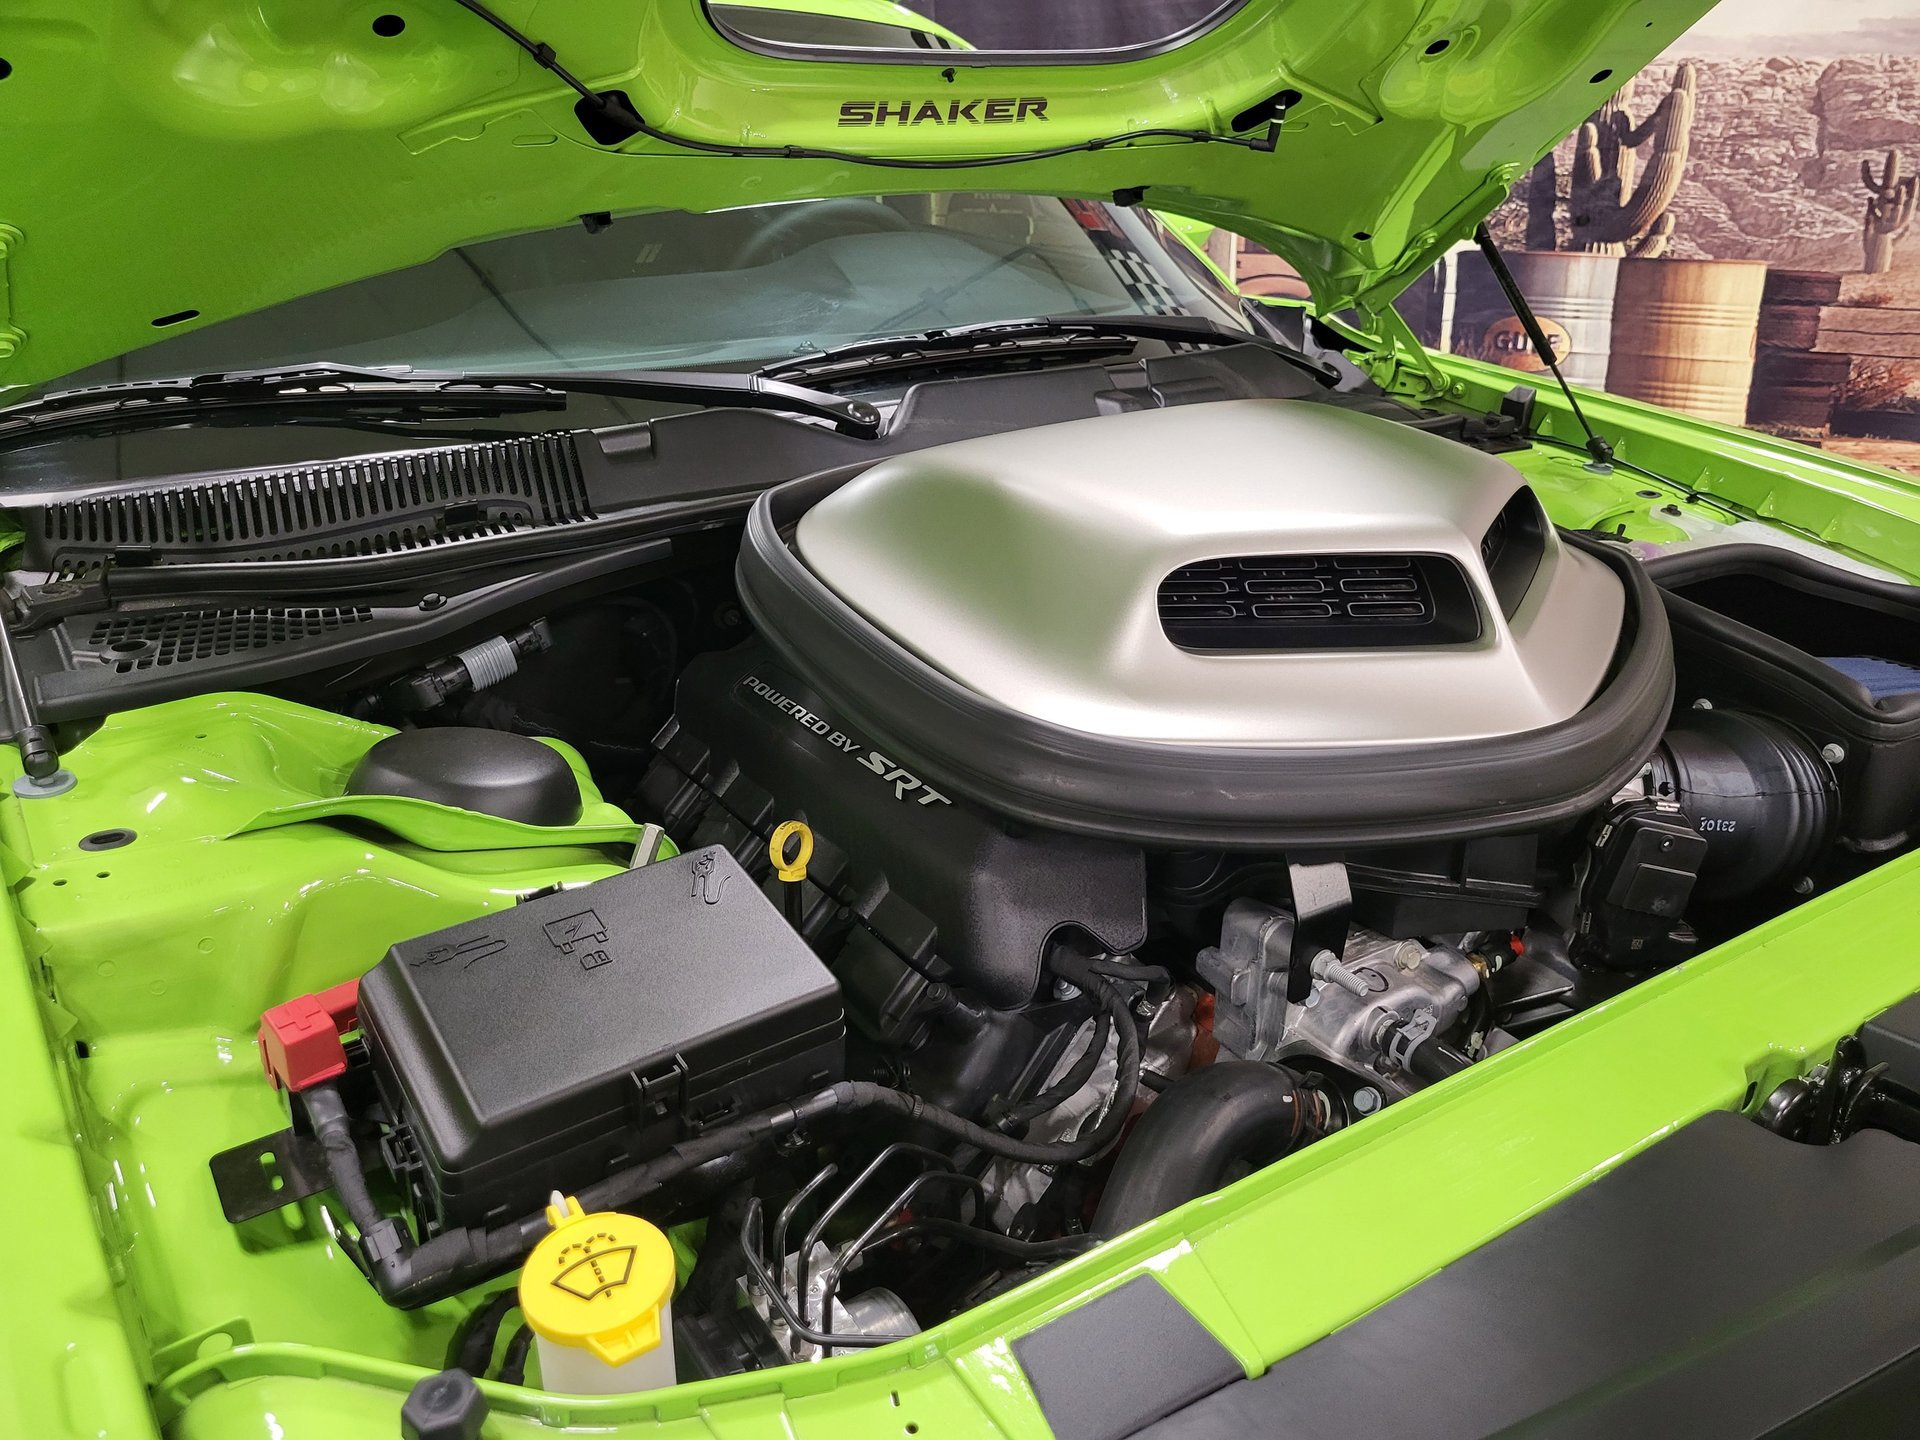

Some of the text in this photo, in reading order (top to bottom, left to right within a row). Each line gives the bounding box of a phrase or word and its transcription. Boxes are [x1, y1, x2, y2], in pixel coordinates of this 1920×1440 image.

[837, 96, 1049, 128] SHAKER
[1494, 330, 1560, 354] GUF
[743, 675, 953, 805] POWERED BY SRT
